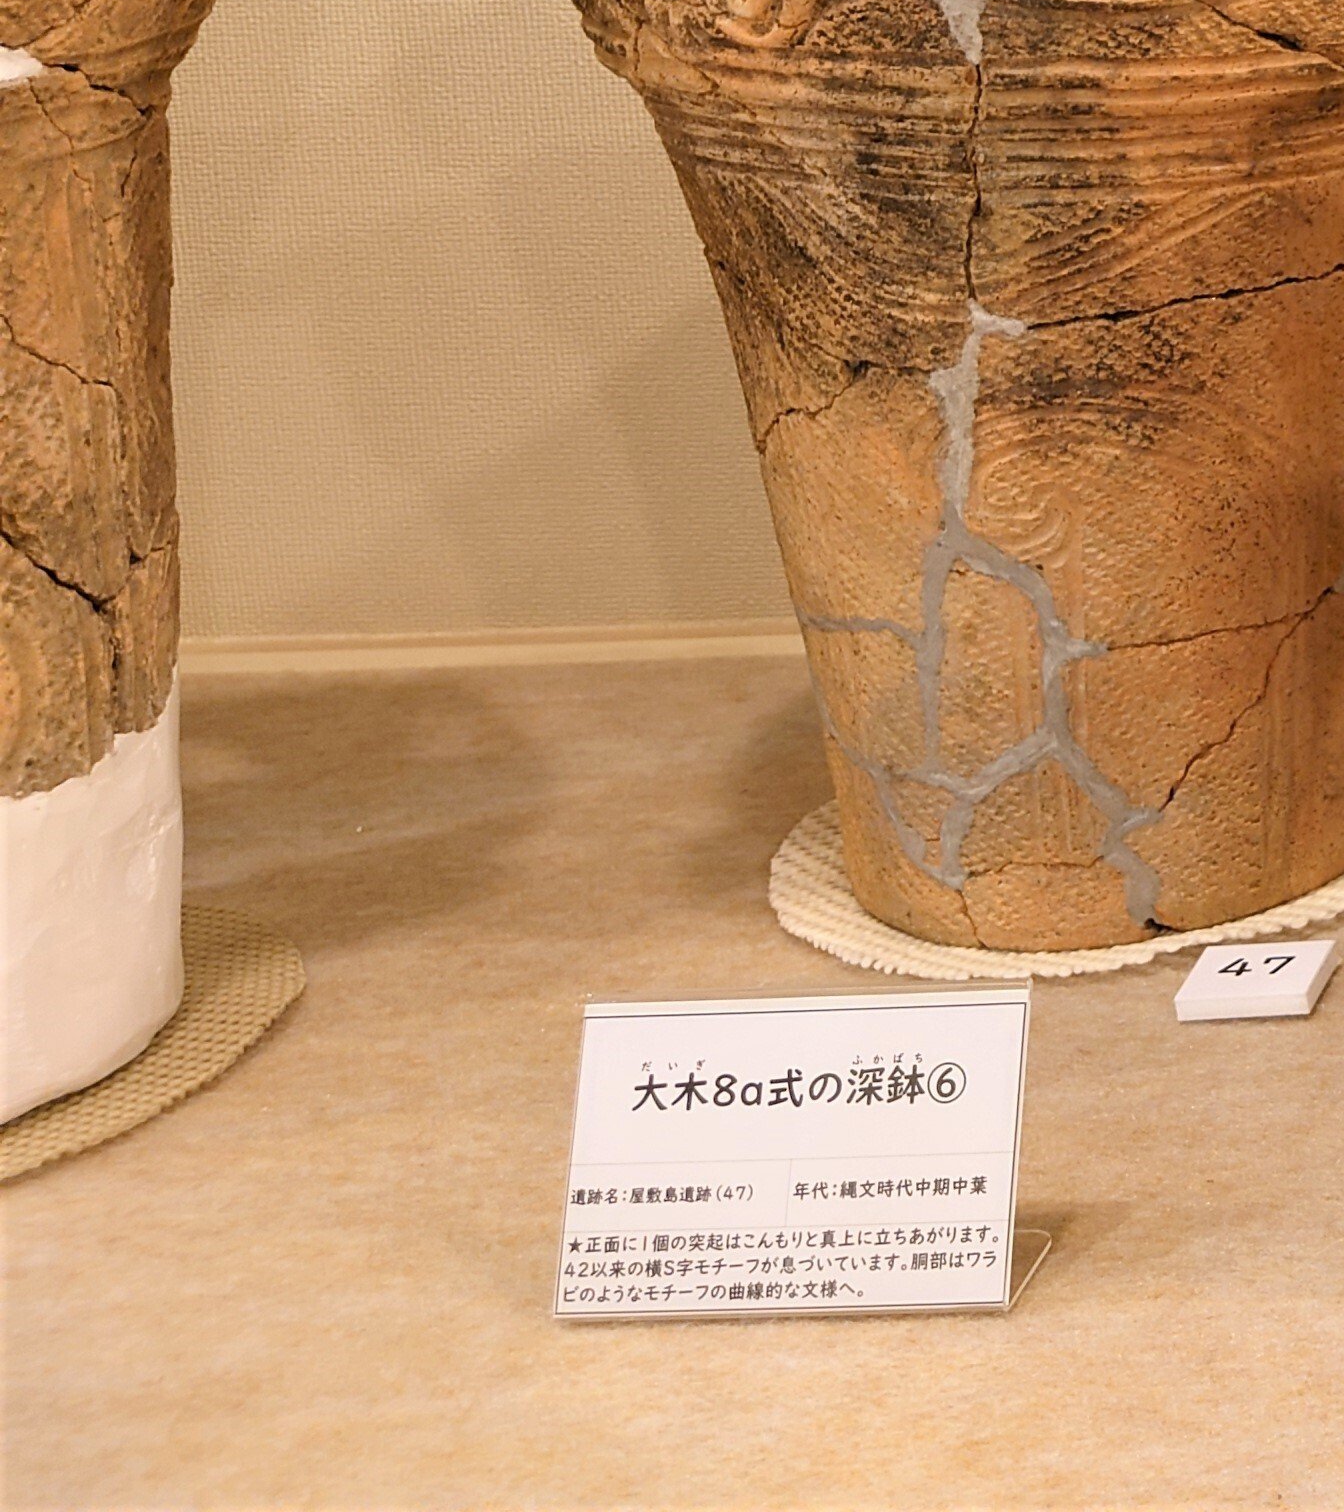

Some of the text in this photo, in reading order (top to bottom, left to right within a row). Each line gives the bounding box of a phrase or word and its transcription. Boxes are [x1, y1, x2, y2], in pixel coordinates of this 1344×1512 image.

[1217, 955, 1297, 977] 47
[631, 1061, 967, 1112] 大木8a式の深鉢⑥
[792, 1175, 988, 1201] 年代：縄文時代中期中葉
[563, 1279, 865, 1303] ビのようなモチーフの曲線的な文様へ。
